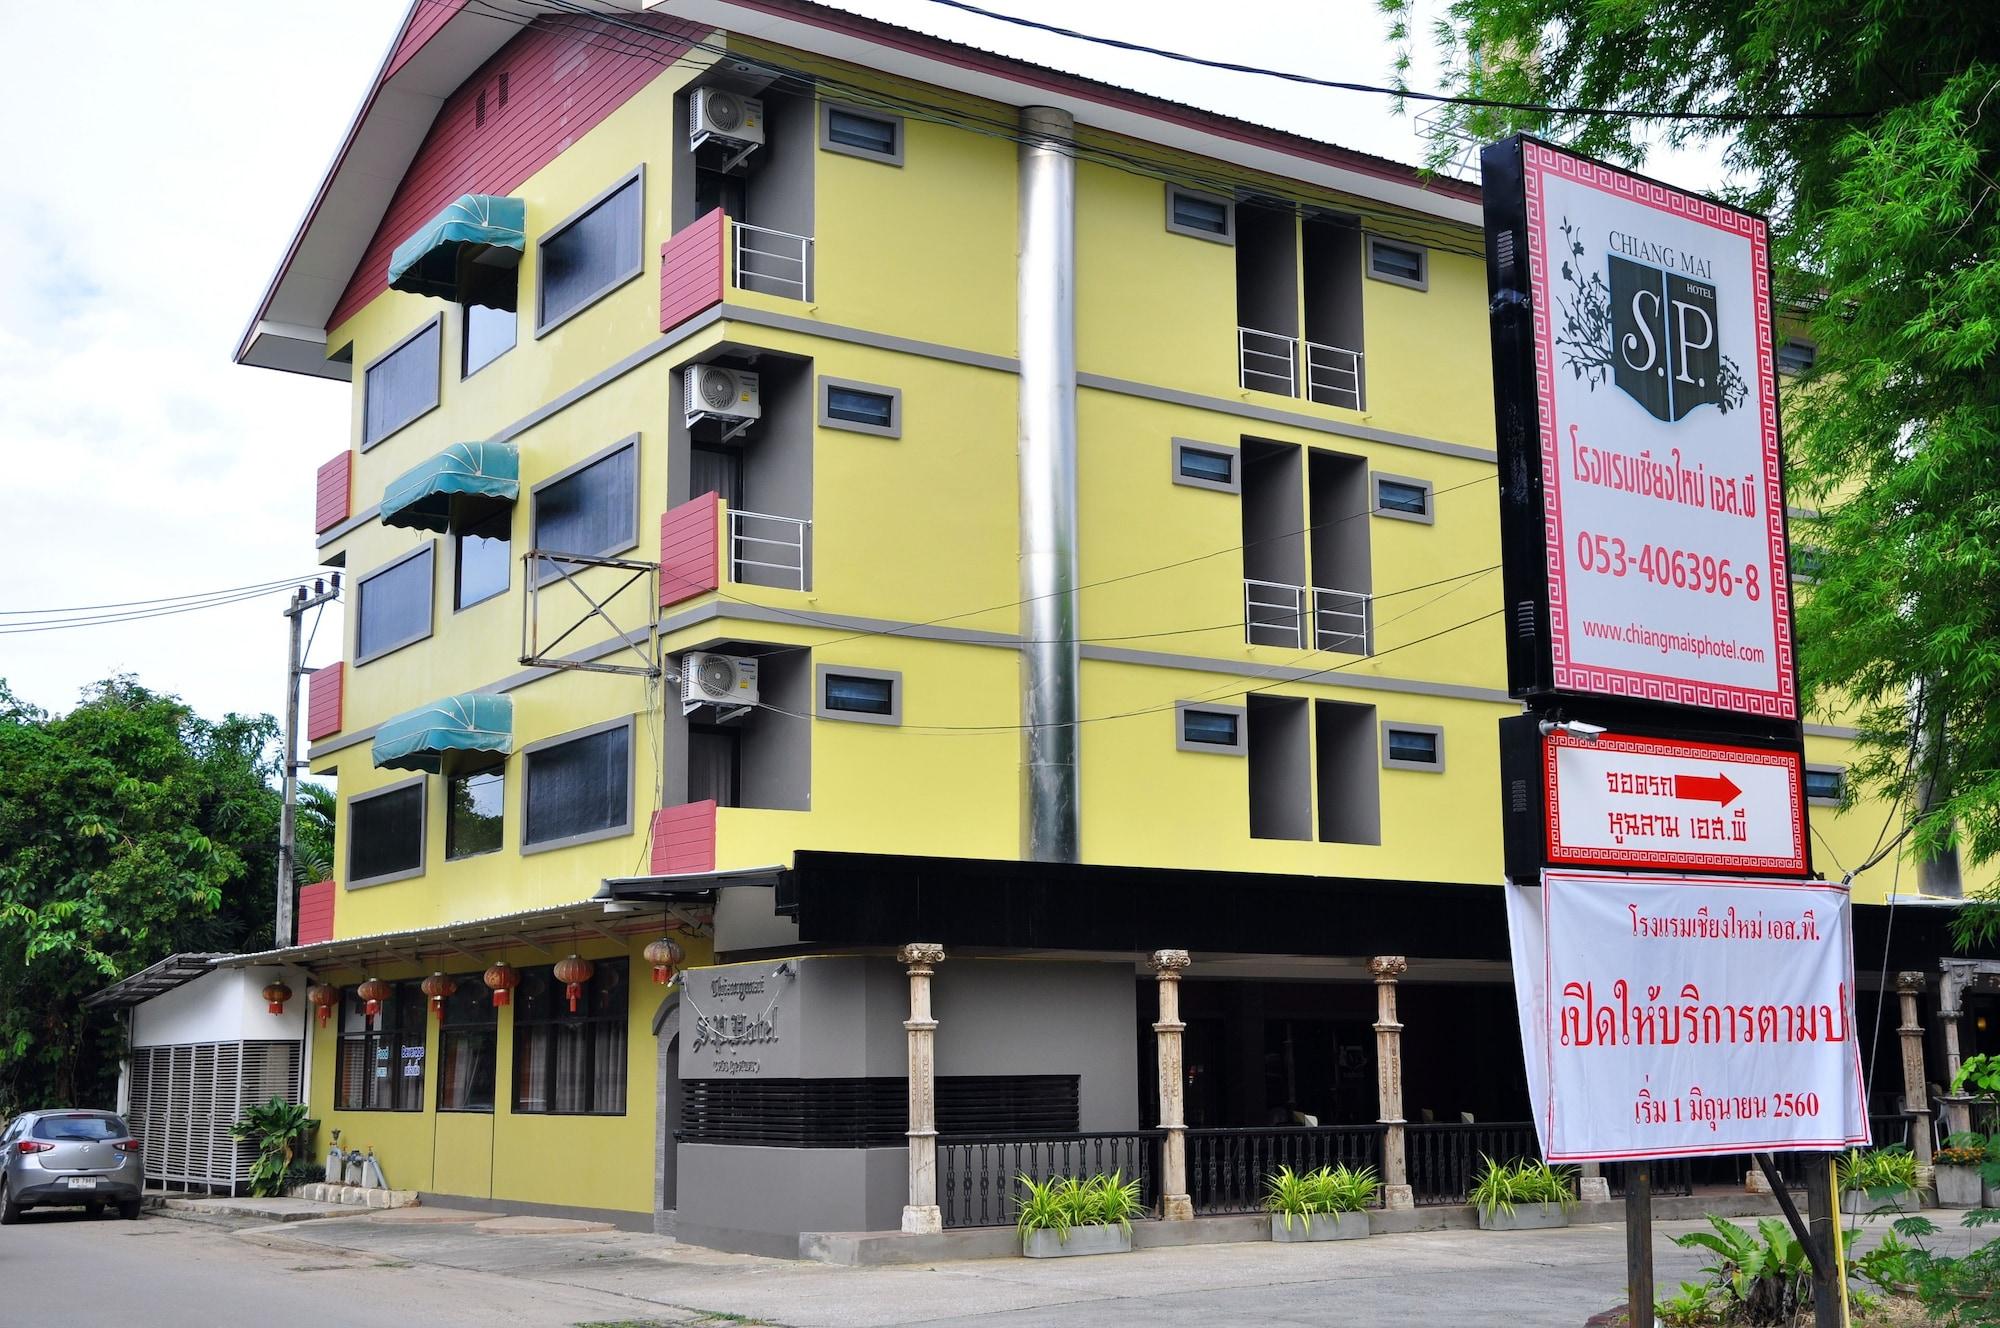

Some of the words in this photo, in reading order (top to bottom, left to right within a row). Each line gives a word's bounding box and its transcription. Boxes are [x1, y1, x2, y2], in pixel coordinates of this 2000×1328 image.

[1608, 230, 1675, 268] CHIANG
[1681, 251, 1713, 280] MAI
[1686, 283, 1714, 300] HOTEL
[1569, 424, 1706, 508] โรงแรมเชียงใหม่
[1709, 474, 1756, 518] เอส.พี
[1577, 530, 1761, 602] 053-406396-8
[1582, 619, 1766, 664] www.chiangmaisphotel.com
[1606, 771, 1674, 798] จอดรถ
[1607, 811, 1681, 845] หูฉลาม
[1690, 807, 1748, 843] เอส.พี
[1627, 903, 1763, 940] โรงแรมเชียงใหม่
[1767, 908, 1821, 941] เอส.พี.
[1560, 978, 1850, 1047] เปิดให้บริการตามป
[1634, 1073, 1667, 1125] เริ่ม
[1673, 1096, 1682, 1123] 1
[1688, 1086, 1768, 1132] มิถุนายน
[1772, 1091, 1821, 1119] 2560
